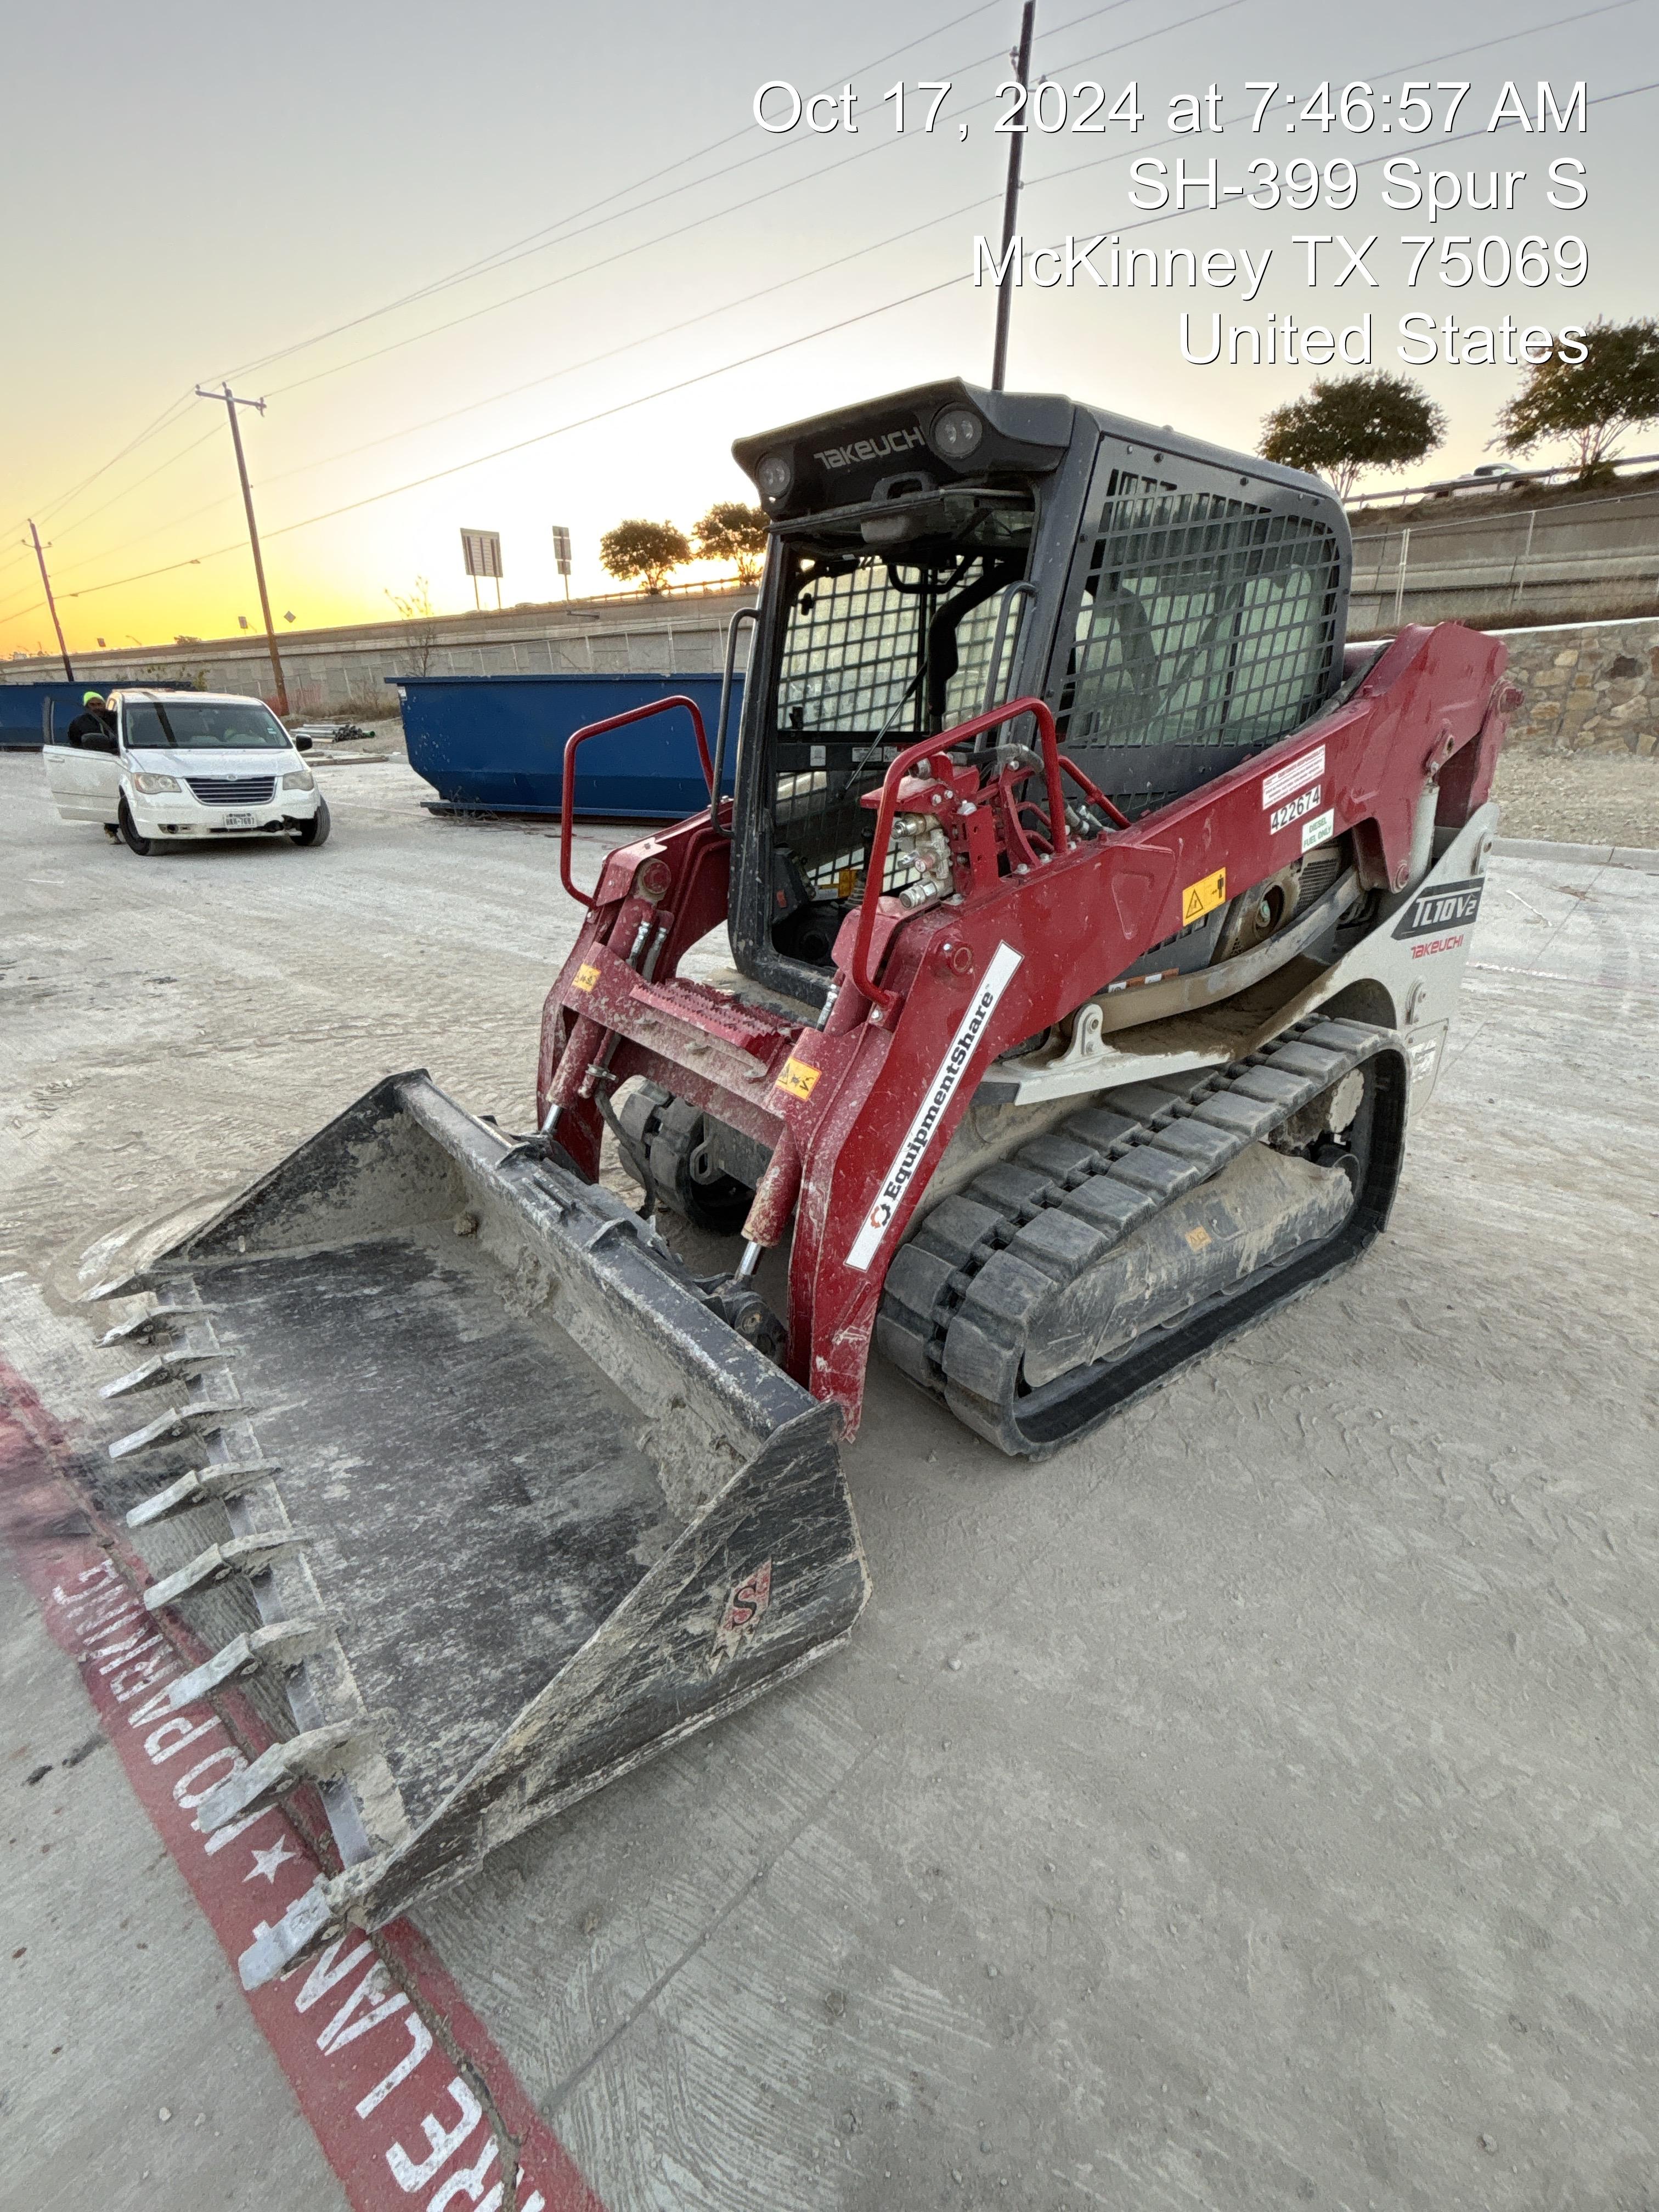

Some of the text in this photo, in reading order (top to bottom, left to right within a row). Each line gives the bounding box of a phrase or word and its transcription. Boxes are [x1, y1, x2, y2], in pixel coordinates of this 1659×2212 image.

[813, 426, 926, 470] TAKEUCH
[1271, 786, 1320, 830] 422674
[1309, 817, 1327, 833] DIESEL
[1303, 825, 1332, 848] FUEL ONLY
[1412, 896, 1477, 928] TL10V2
[1410, 934, 1464, 960] TAKEUCHI
[882, 989, 995, 1201] EquipmentShare
[52, 1558, 223, 1765] PARKING
[252, 1899, 434, 2120] LAN
